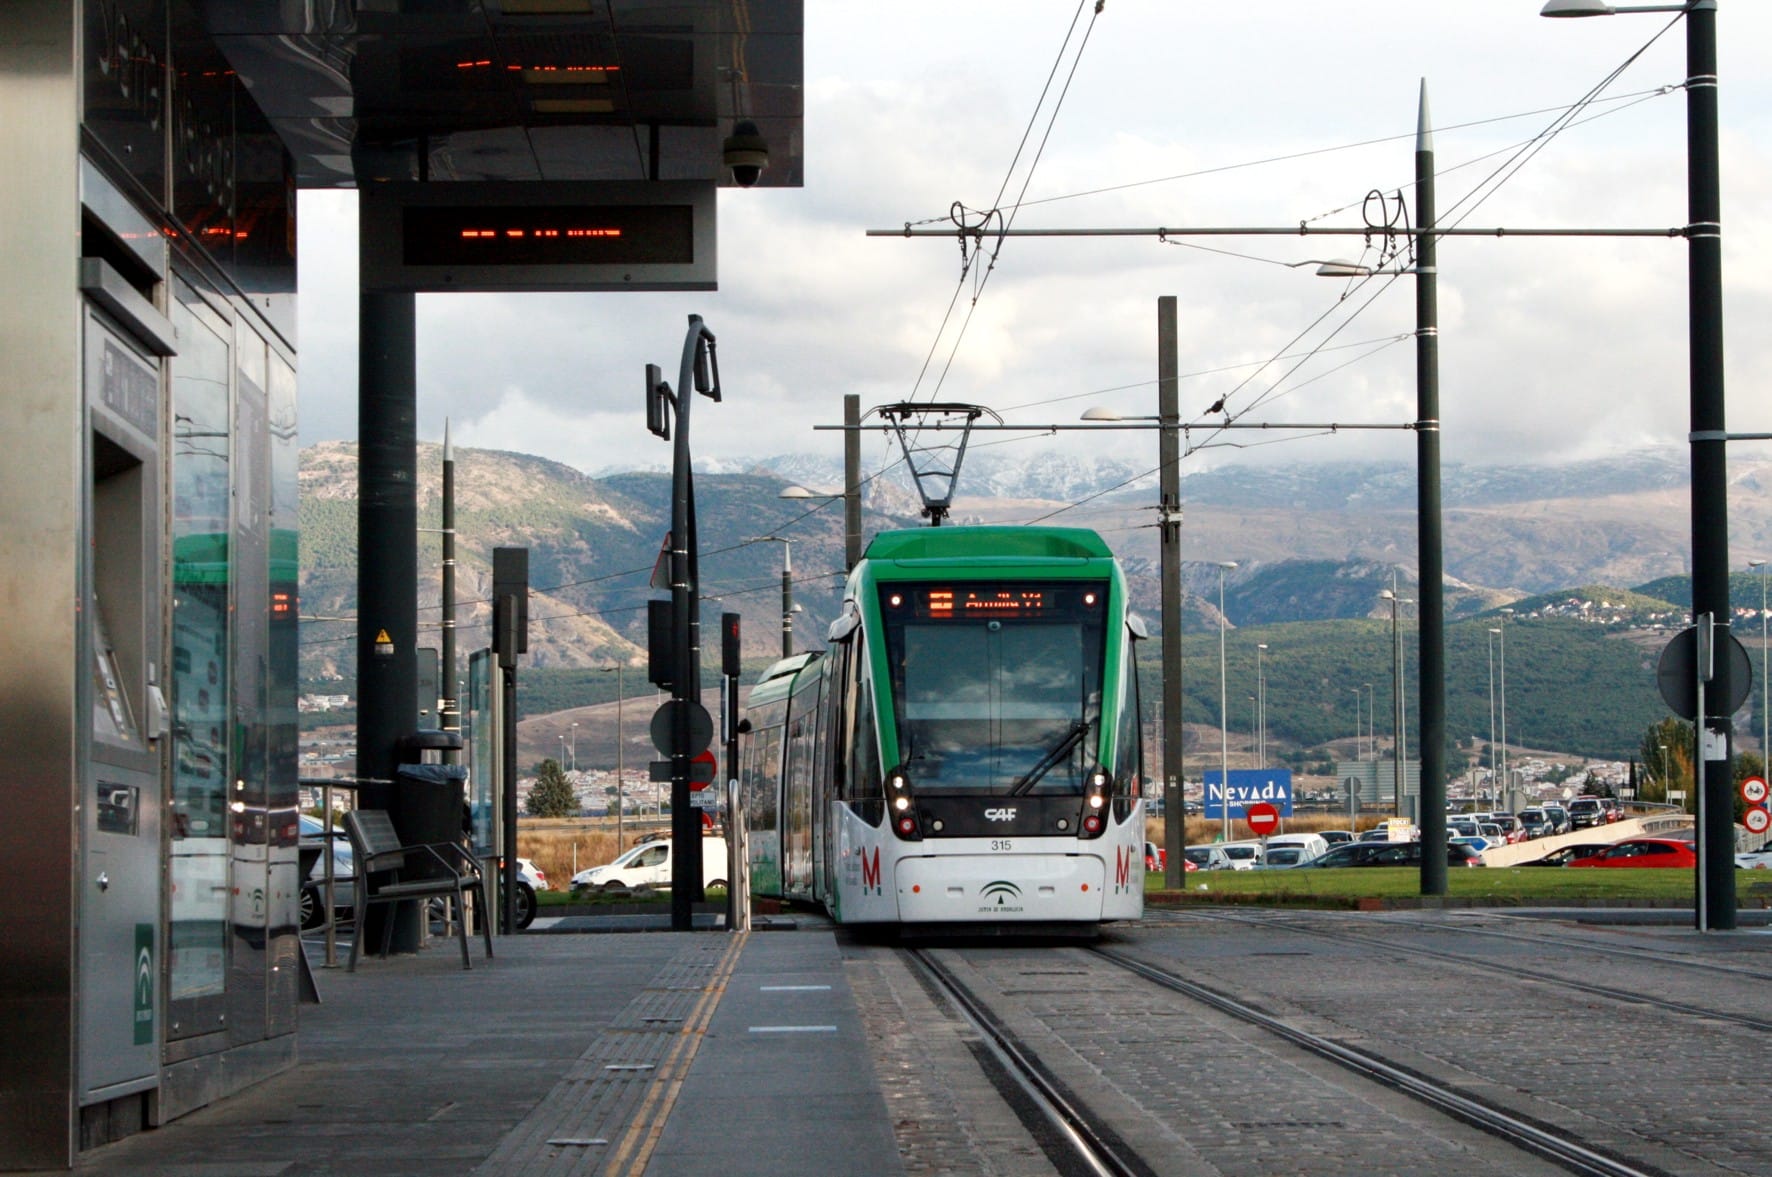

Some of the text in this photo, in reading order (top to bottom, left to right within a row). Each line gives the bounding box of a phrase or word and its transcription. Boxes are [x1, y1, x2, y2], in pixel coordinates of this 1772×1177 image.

[1208, 780, 1287, 800] Nevada
[984, 808, 1017, 821] CAF
[991, 839, 1012, 851] 315
[861, 845, 882, 896] M
[1115, 843, 1130, 895] M
